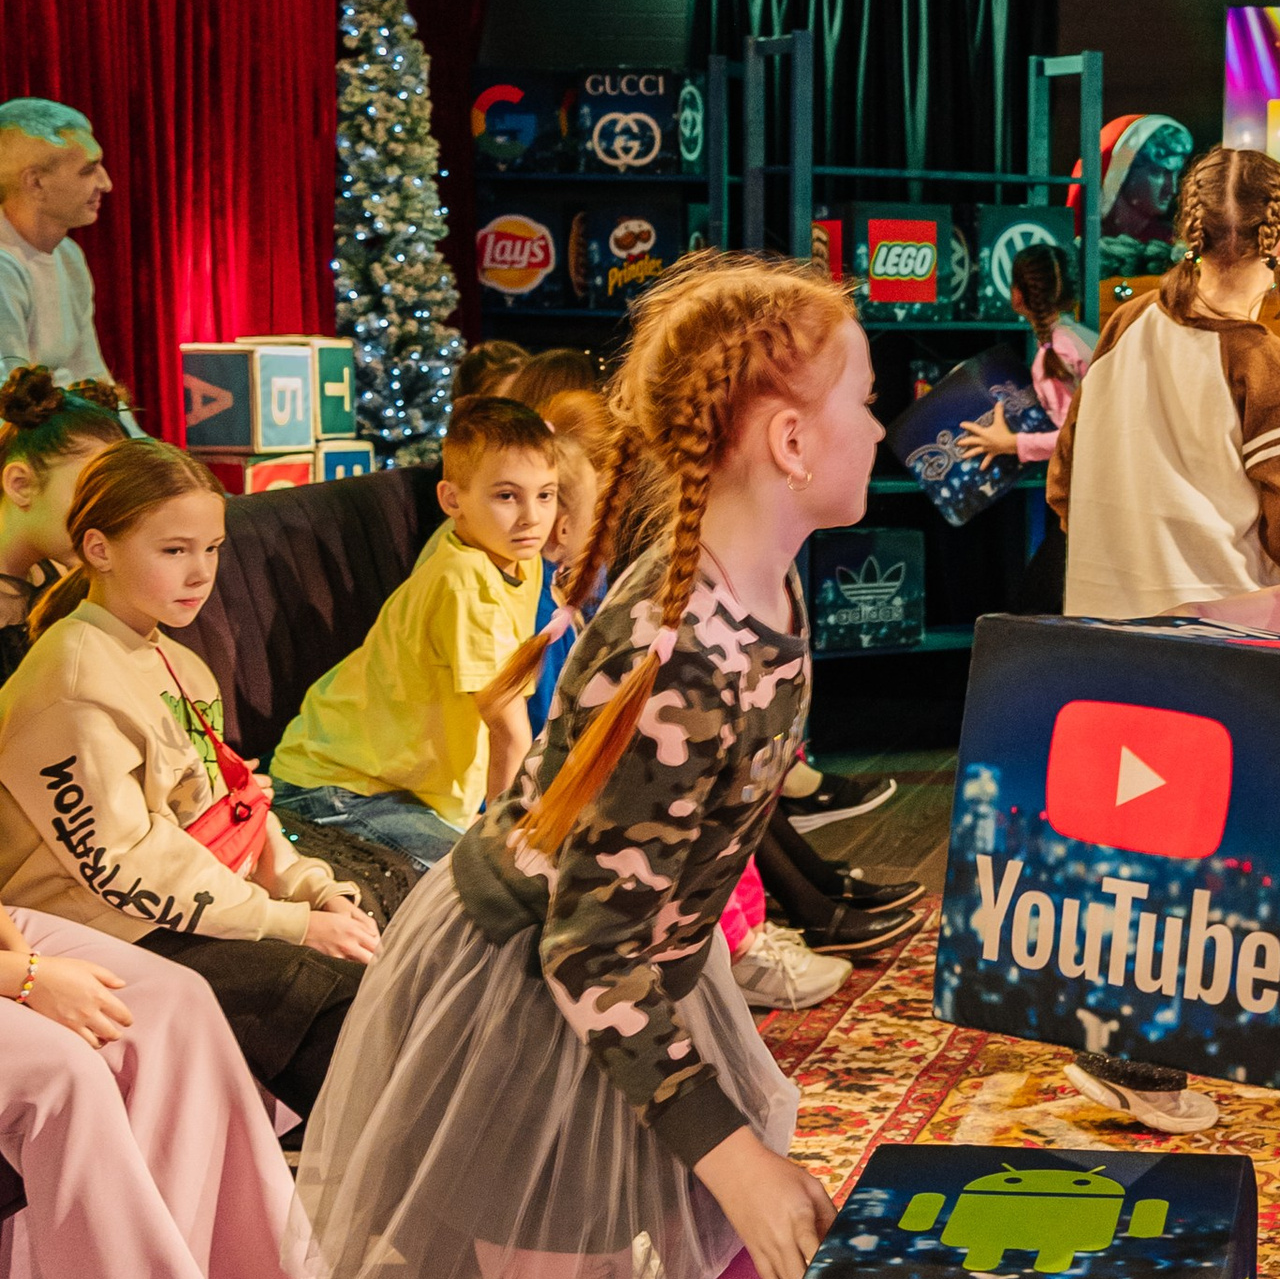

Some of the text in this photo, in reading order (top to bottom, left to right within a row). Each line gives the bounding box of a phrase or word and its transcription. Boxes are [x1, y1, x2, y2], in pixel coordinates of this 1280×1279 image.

[585, 74, 665, 96] GUCCI
[873, 242, 934, 278] LEGO
[835, 602, 903, 625] adidas
[40, 755, 214, 933] INSPIRATION
